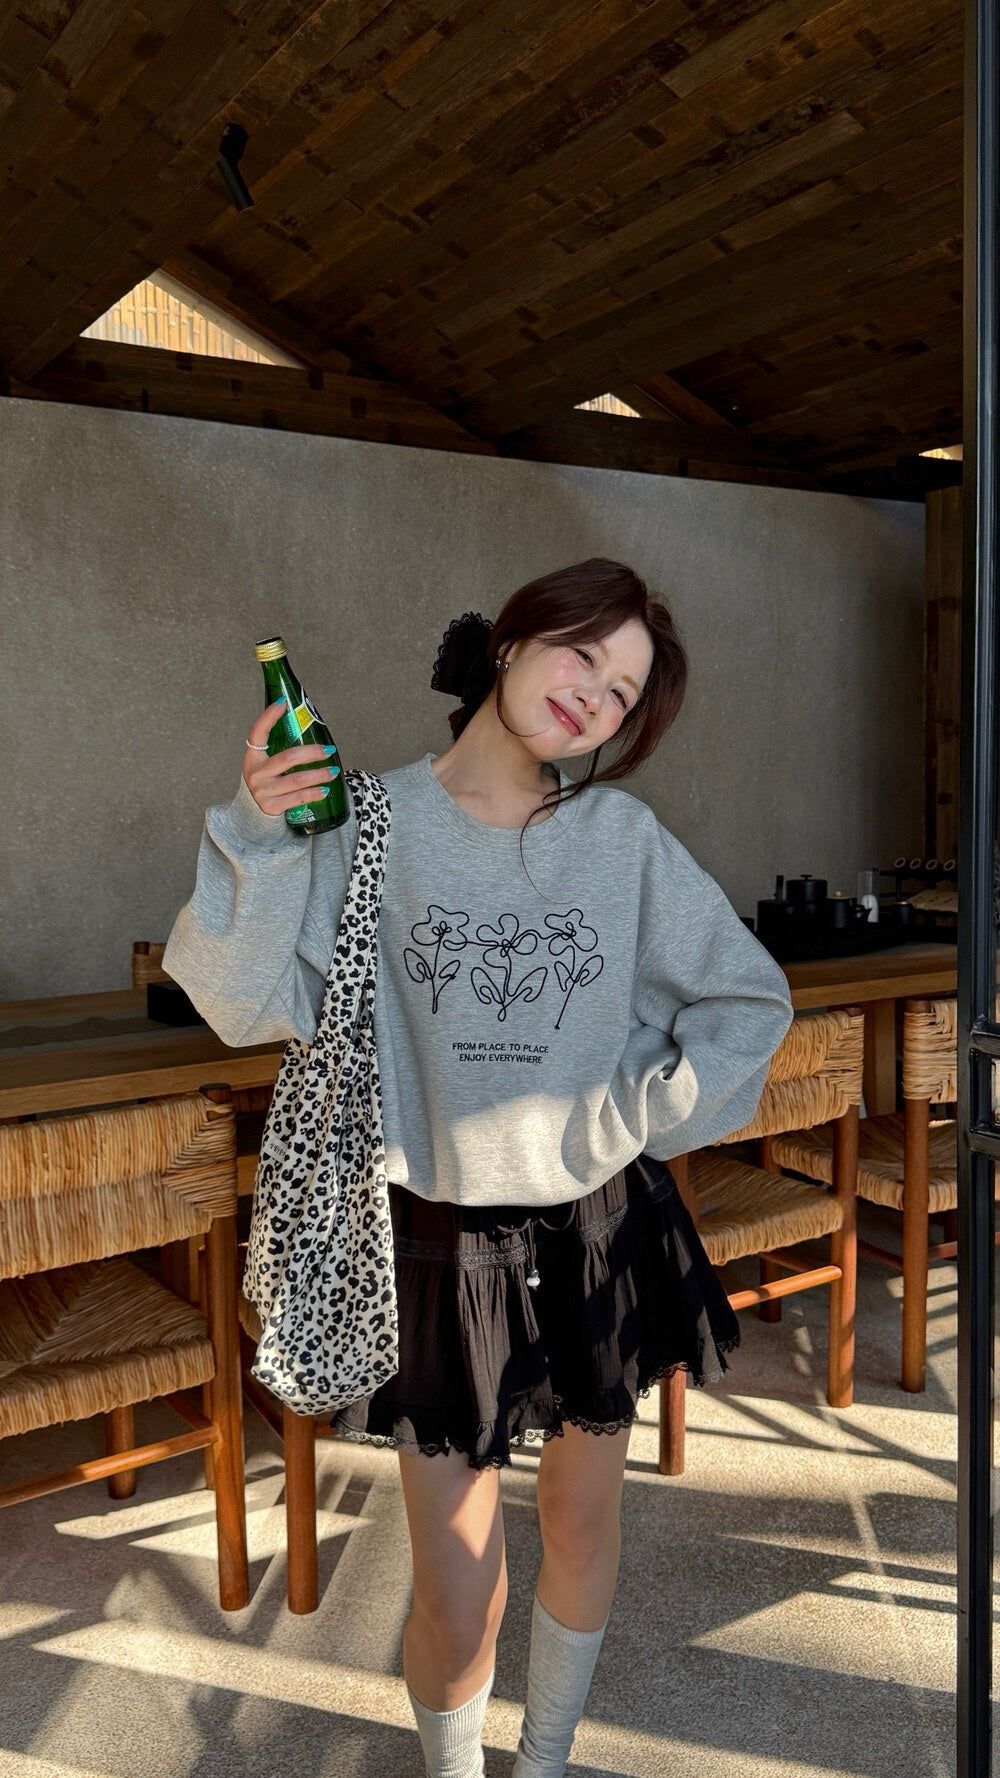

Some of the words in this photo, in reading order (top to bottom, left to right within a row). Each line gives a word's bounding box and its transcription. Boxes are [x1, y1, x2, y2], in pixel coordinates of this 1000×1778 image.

[452, 1042, 476, 1050] FROM
[478, 1043, 506, 1051] PLACE
[509, 1043, 521, 1051] TO
[523, 1044, 549, 1053] PLACE
[459, 1054, 487, 1062] ENJOY
[488, 1054, 543, 1063] EVERYWHERE
